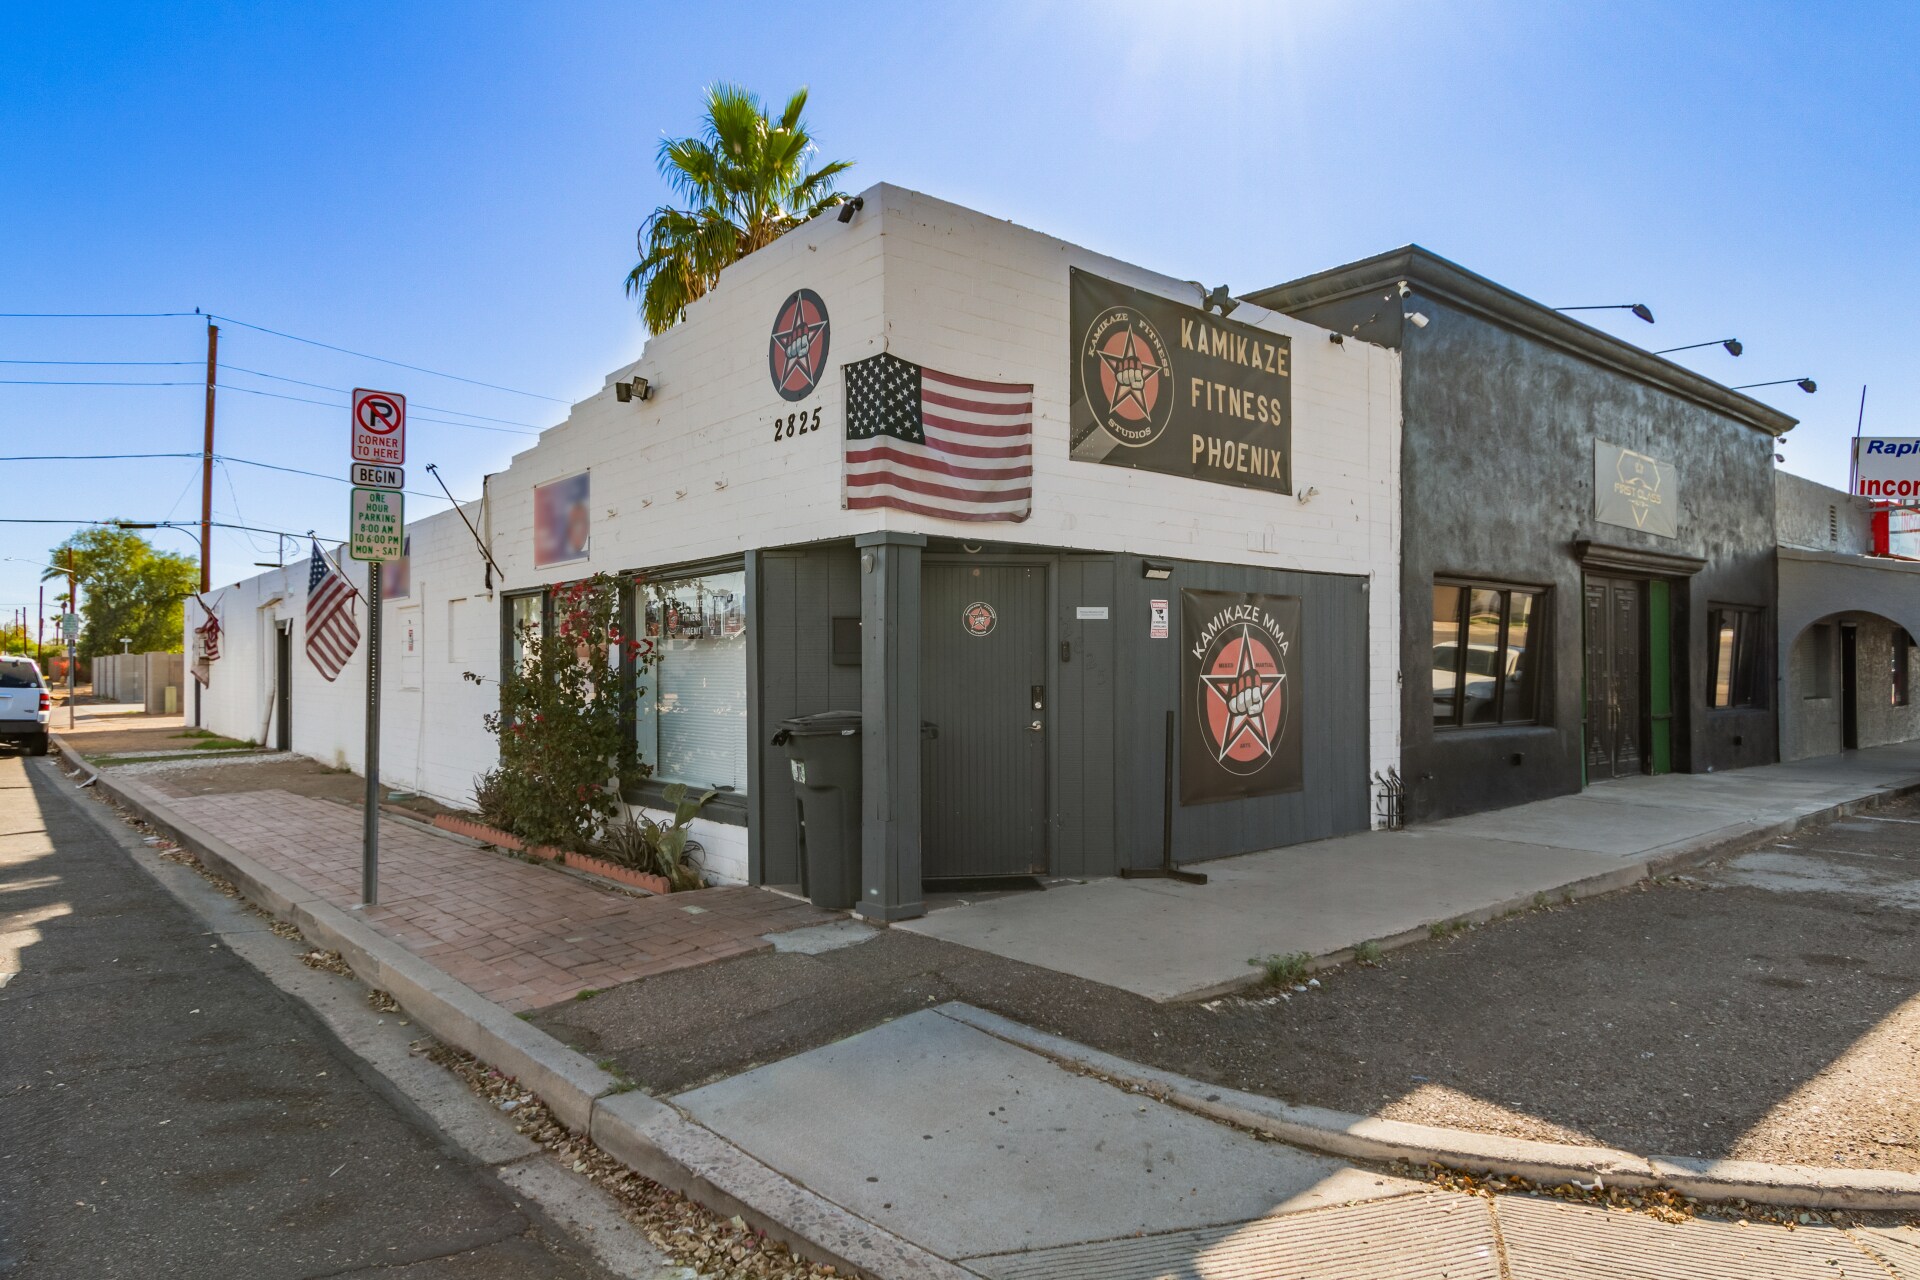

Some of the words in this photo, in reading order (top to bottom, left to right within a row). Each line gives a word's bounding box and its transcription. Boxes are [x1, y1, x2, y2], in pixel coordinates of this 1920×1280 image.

[1088, 312, 1129, 358] KAMIKAZE
[1138, 319, 1170, 377] FITNESS
[1181, 317, 1289, 377] KAMIKAZE
[1191, 377, 1282, 427] FITNESS
[774, 406, 822, 442] 2825
[1107, 418, 1152, 439] STUDIOS
[358, 434, 399, 449] CORNER
[1867, 440, 1920, 457] Rapi
[357, 446, 370, 457] TO
[373, 447, 399, 460] HERE
[1191, 433, 1281, 479] PHOENIX
[360, 468, 396, 484] BEGIN
[369, 493, 386, 503] ONE
[366, 503, 389, 513] HOUR
[358, 512, 396, 523] PARKING
[360, 524, 380, 534] 8:00
[382, 524, 394, 534] AM
[354, 533, 365, 543] TO
[366, 534, 386, 544] 6:00
[388, 535, 399, 545] PM
[355, 545, 374, 555] MON
[382, 546, 398, 556] SAT
[1192, 604, 1260, 660] KAMIKAZE
[1262, 613, 1290, 656] MMA
